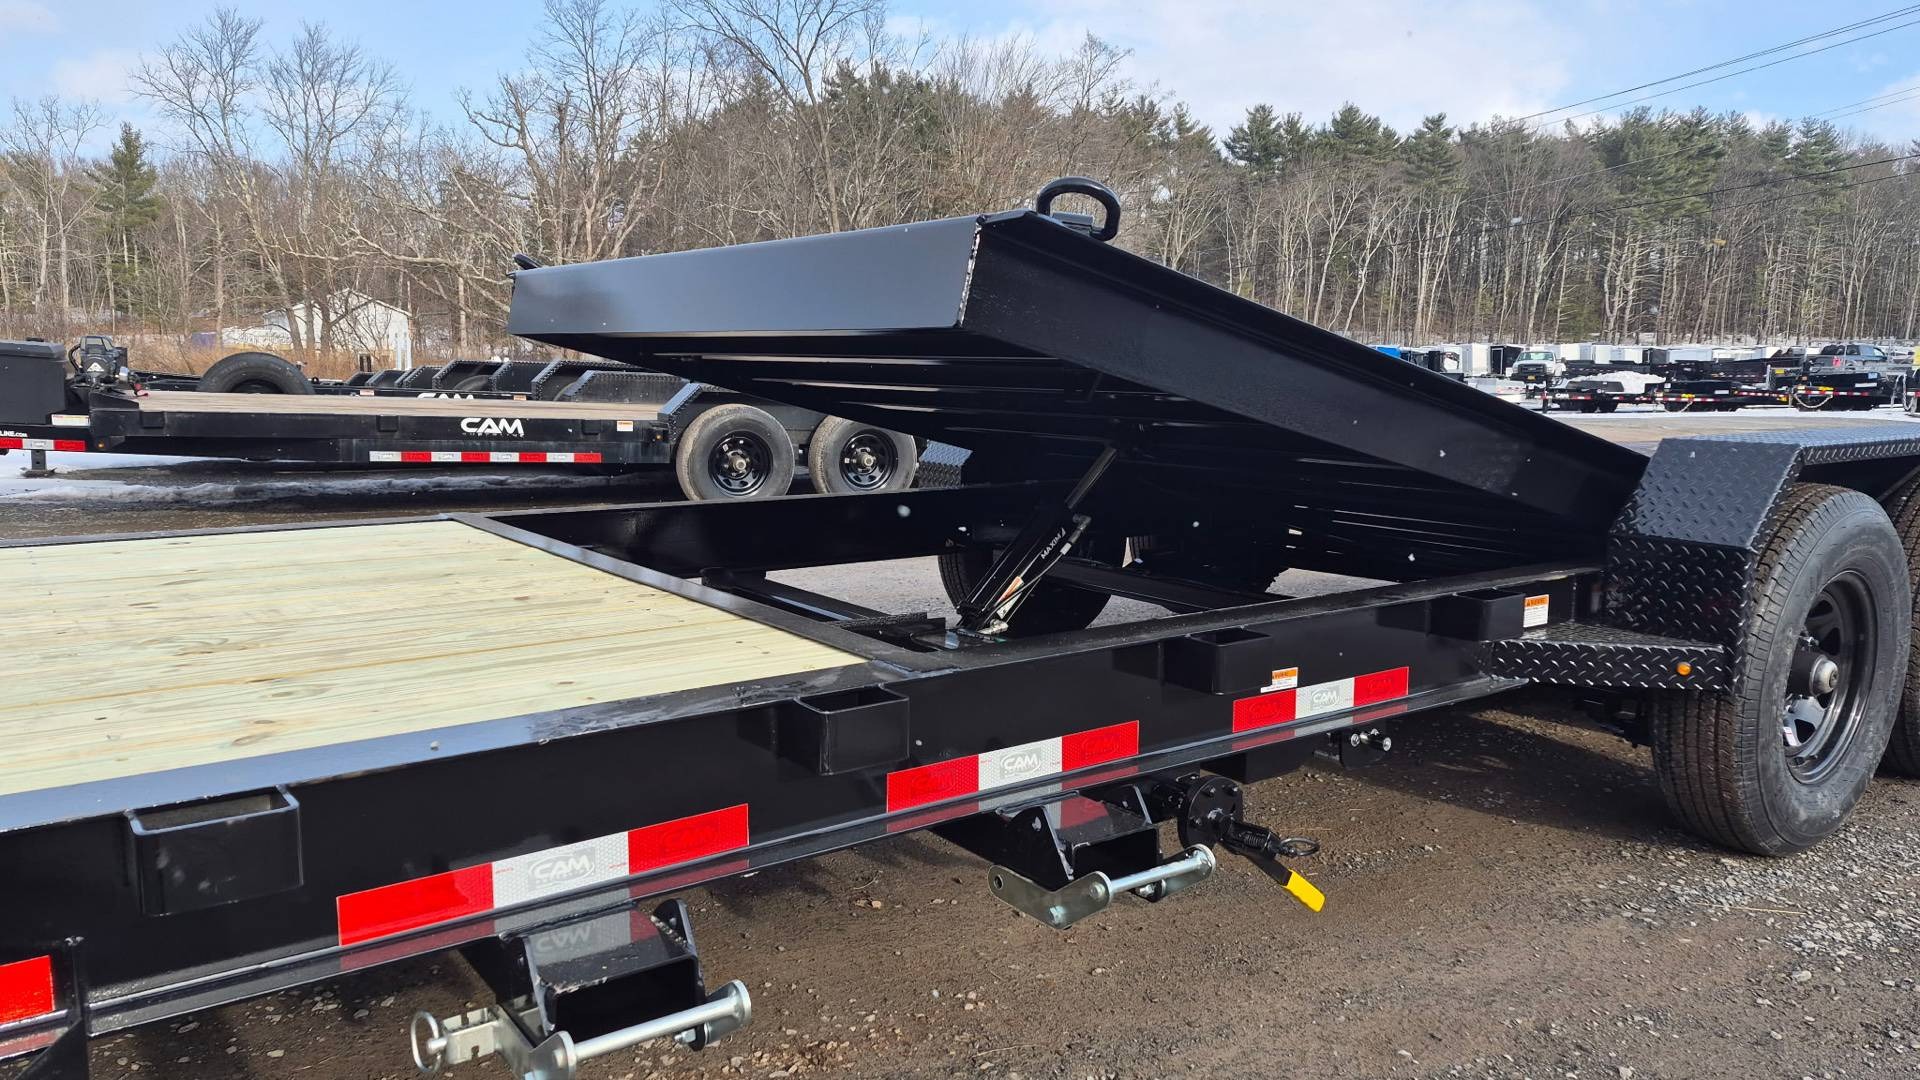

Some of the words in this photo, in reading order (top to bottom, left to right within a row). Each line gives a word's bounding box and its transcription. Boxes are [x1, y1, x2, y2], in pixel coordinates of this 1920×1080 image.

[461, 417, 524, 434] CAM
[1003, 753, 1038, 771] CAM
[534, 855, 590, 879] CAM
